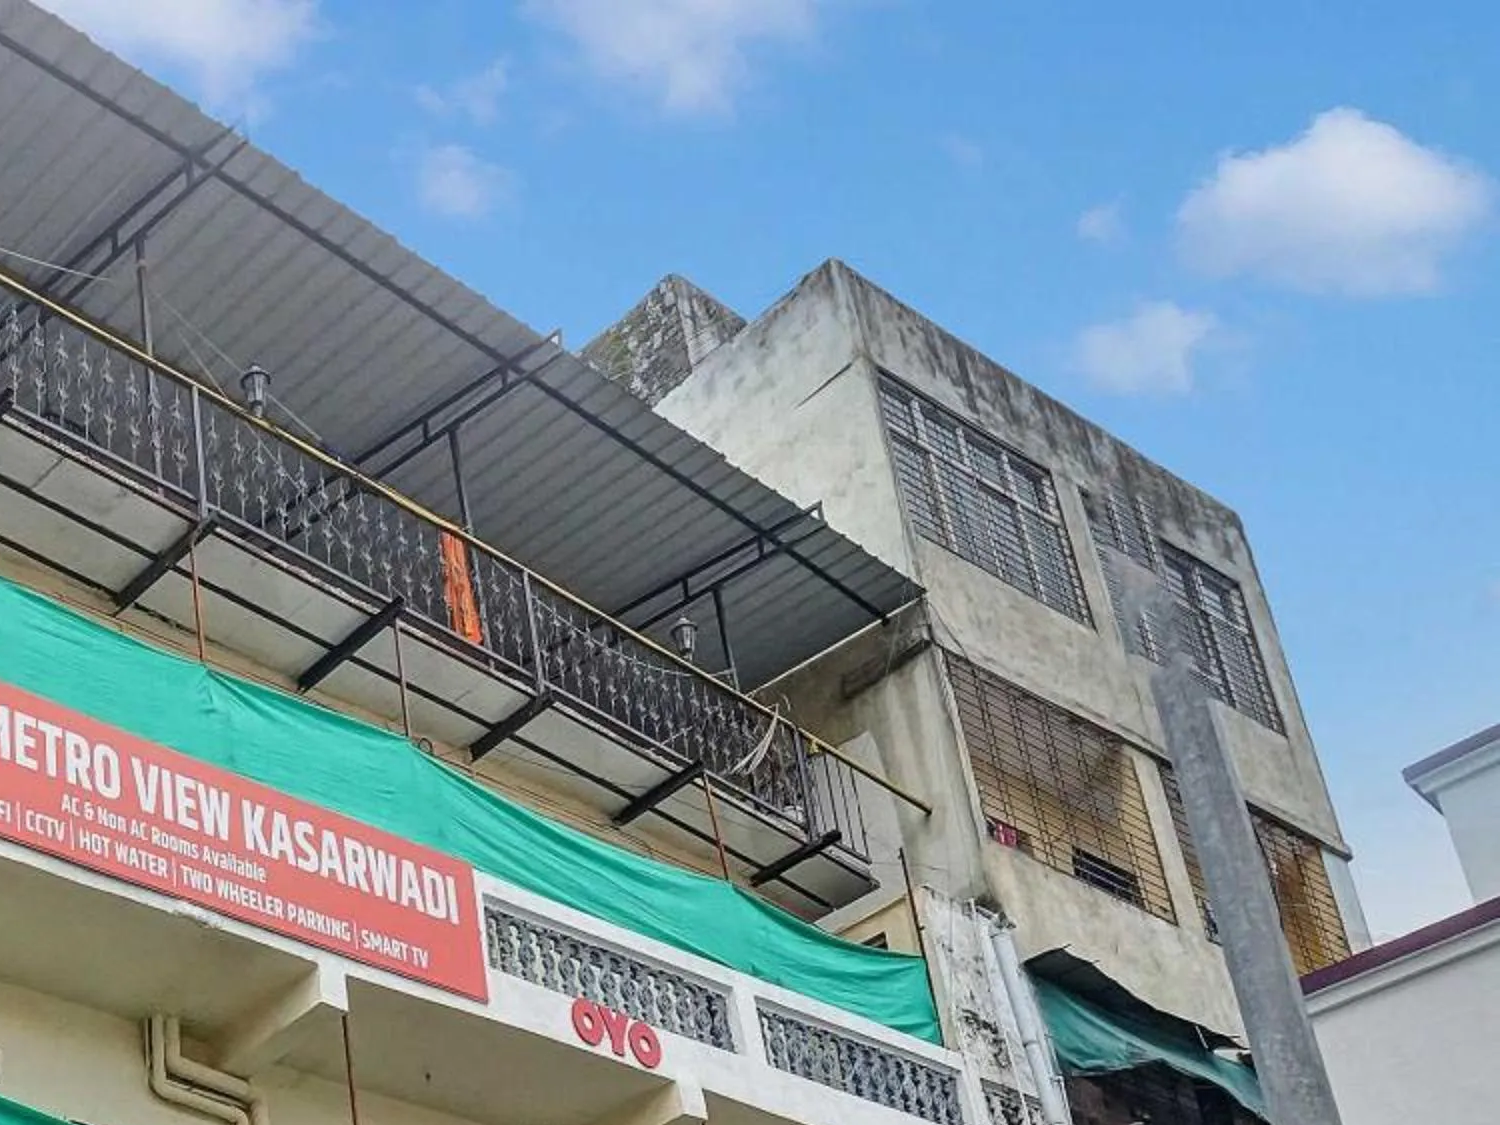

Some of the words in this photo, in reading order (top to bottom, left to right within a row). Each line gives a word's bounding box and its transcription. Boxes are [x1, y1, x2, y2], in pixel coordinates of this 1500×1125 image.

[61, 795, 80, 817] AC
[131, 819, 148, 841] AC
[131, 756, 230, 841] VIEW
[241, 800, 459, 924] KASARWADI
[25, 809, 65, 842] CCTV
[79, 828, 110, 857] HOT
[115, 841, 168, 878] WATER
[180, 865, 213, 894] TWO
[216, 879, 284, 919] WHEELER
[286, 904, 351, 941] PARKING
[360, 928, 411, 962] SMART
[412, 949, 430, 969] TV
[571, 996, 663, 1069] OYO
